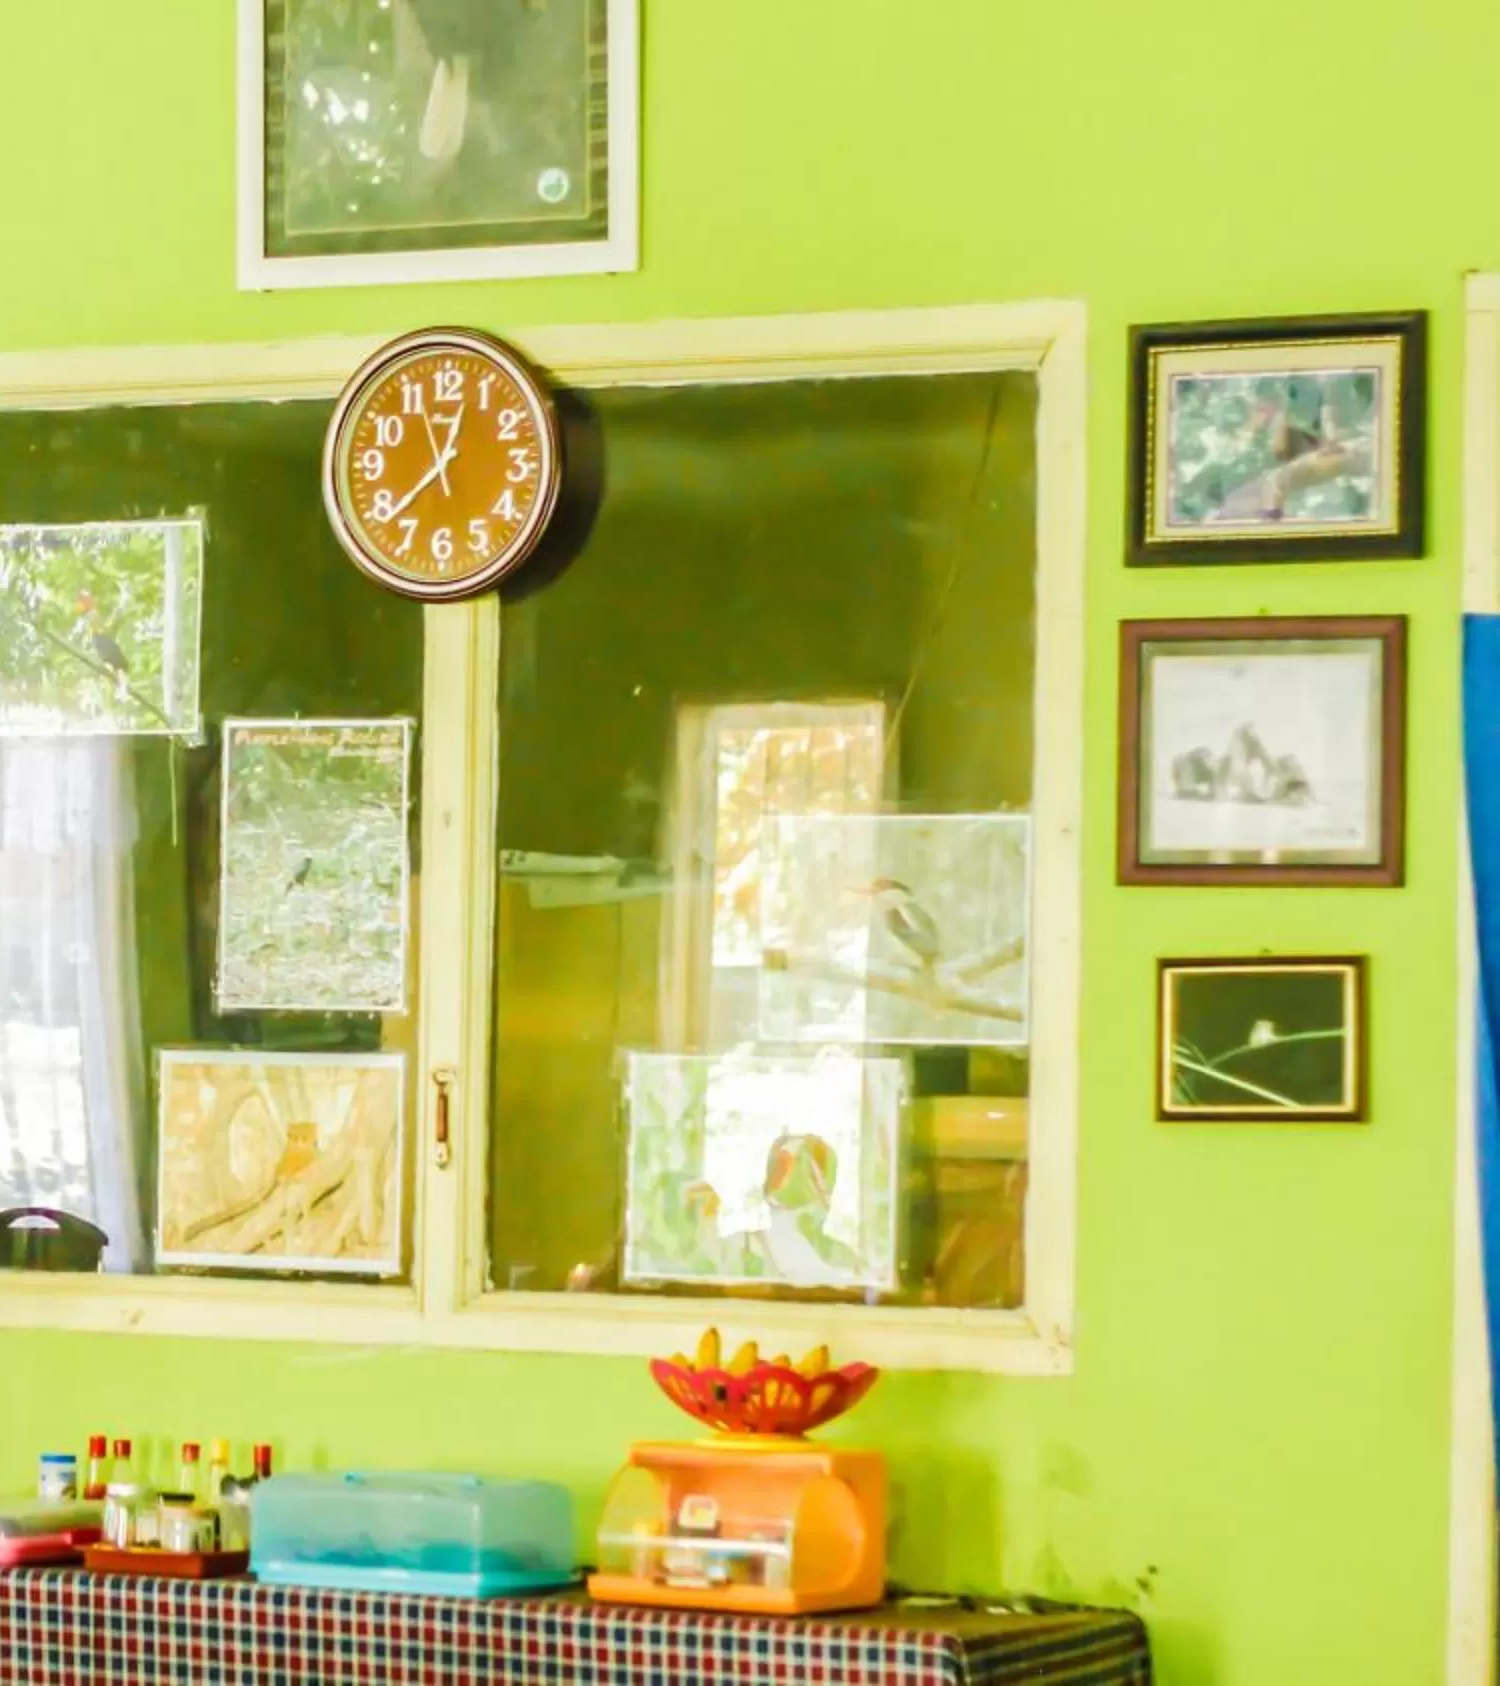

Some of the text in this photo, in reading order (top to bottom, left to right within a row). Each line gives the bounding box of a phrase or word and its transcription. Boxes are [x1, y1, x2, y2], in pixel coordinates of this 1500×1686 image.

[402, 383, 423, 414] 11
[434, 369, 463, 401] 12
[478, 379, 491, 410] 1
[374, 416, 403, 447] 10
[498, 409, 518, 440] 2
[363, 449, 384, 480] 9
[506, 448, 529, 481] 3
[373, 489, 393, 522] 8
[491, 490, 516, 520] 4
[399, 519, 417, 549] 7
[431, 528, 452, 560] 6
[468, 519, 488, 550] 5
